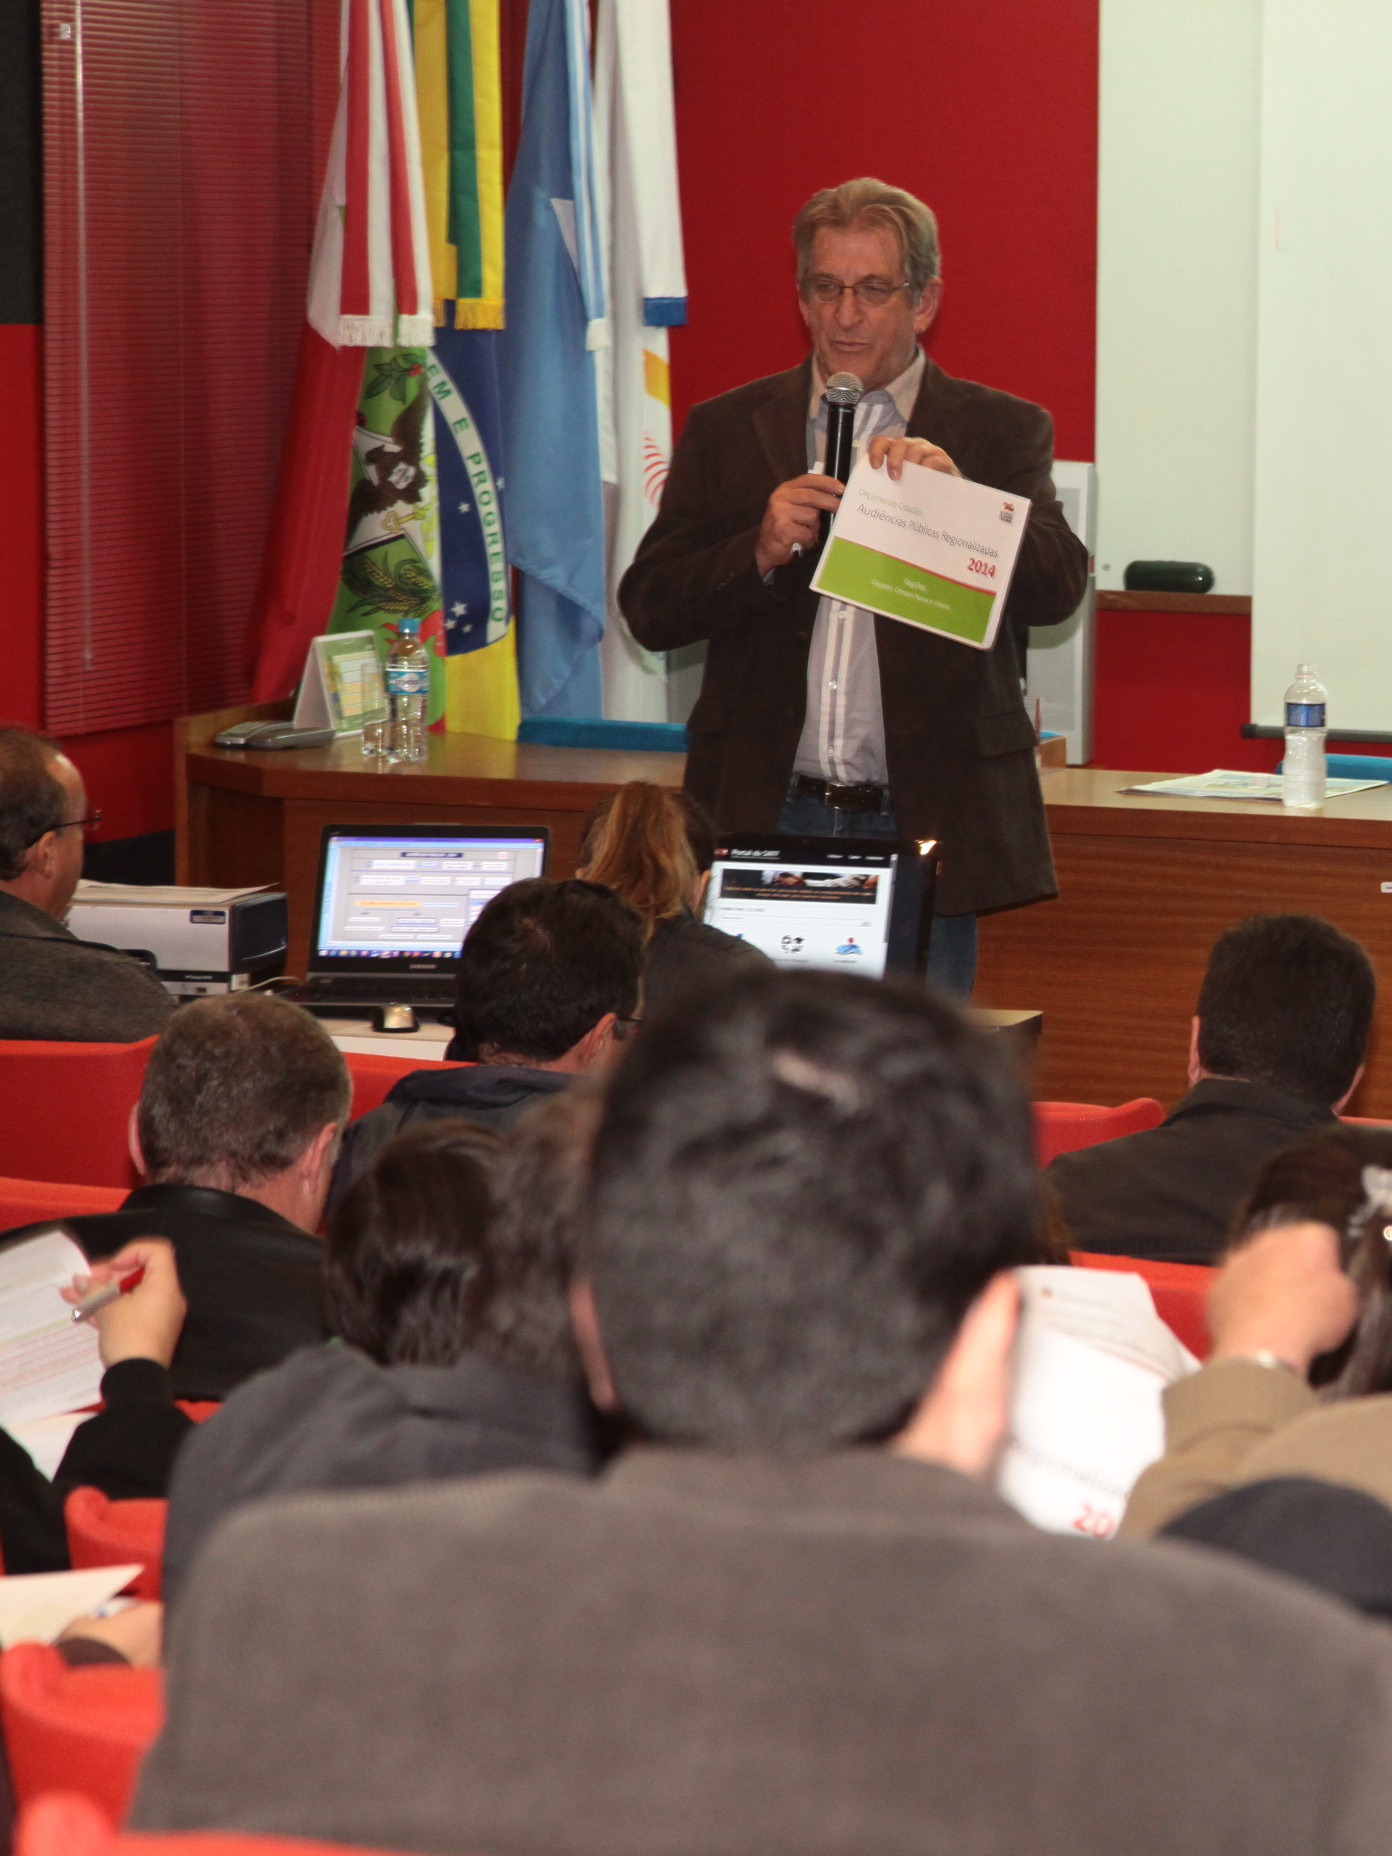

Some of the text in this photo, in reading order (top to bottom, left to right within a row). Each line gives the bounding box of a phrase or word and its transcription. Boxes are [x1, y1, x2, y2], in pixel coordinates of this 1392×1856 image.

[856, 503, 998, 558] Audiências Públicas Regionalizadas
[966, 557, 997, 578] 2014
